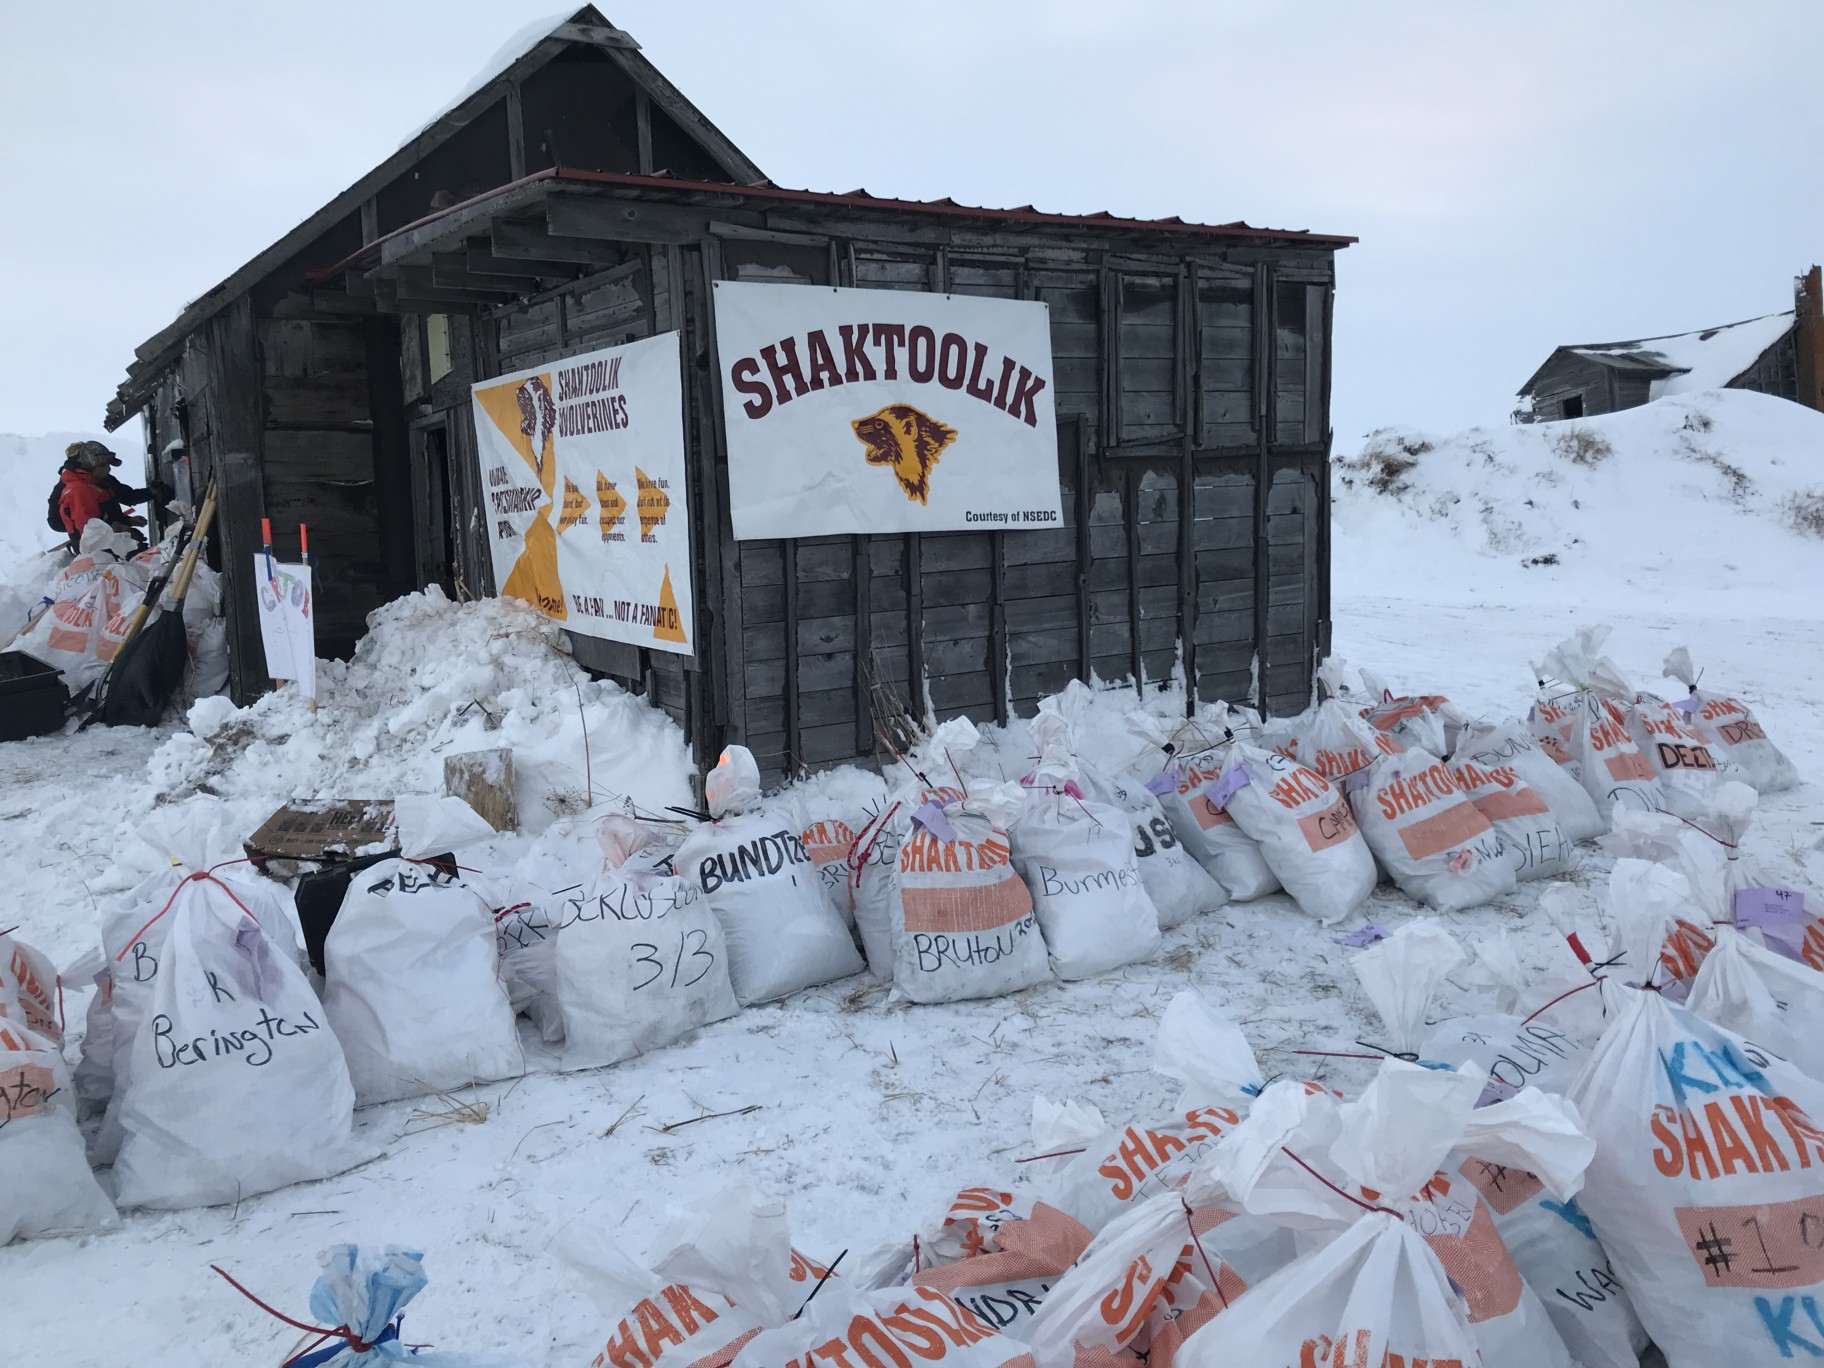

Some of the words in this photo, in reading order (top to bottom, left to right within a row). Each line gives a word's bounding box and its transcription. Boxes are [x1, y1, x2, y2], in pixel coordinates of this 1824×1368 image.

[731, 323, 1046, 428] SHAKTOOLIK
[559, 394, 629, 437] WOLVERINES
[965, 510, 1008, 523] Courtesy
[1011, 511, 1020, 522] of
[1022, 511, 1057, 522] NSEDC
[614, 601, 631, 622] NOT
[632, 603, 638, 624] A
[640, 604, 678, 631] FANATIC!
[631, 929, 714, 991] 3/3
